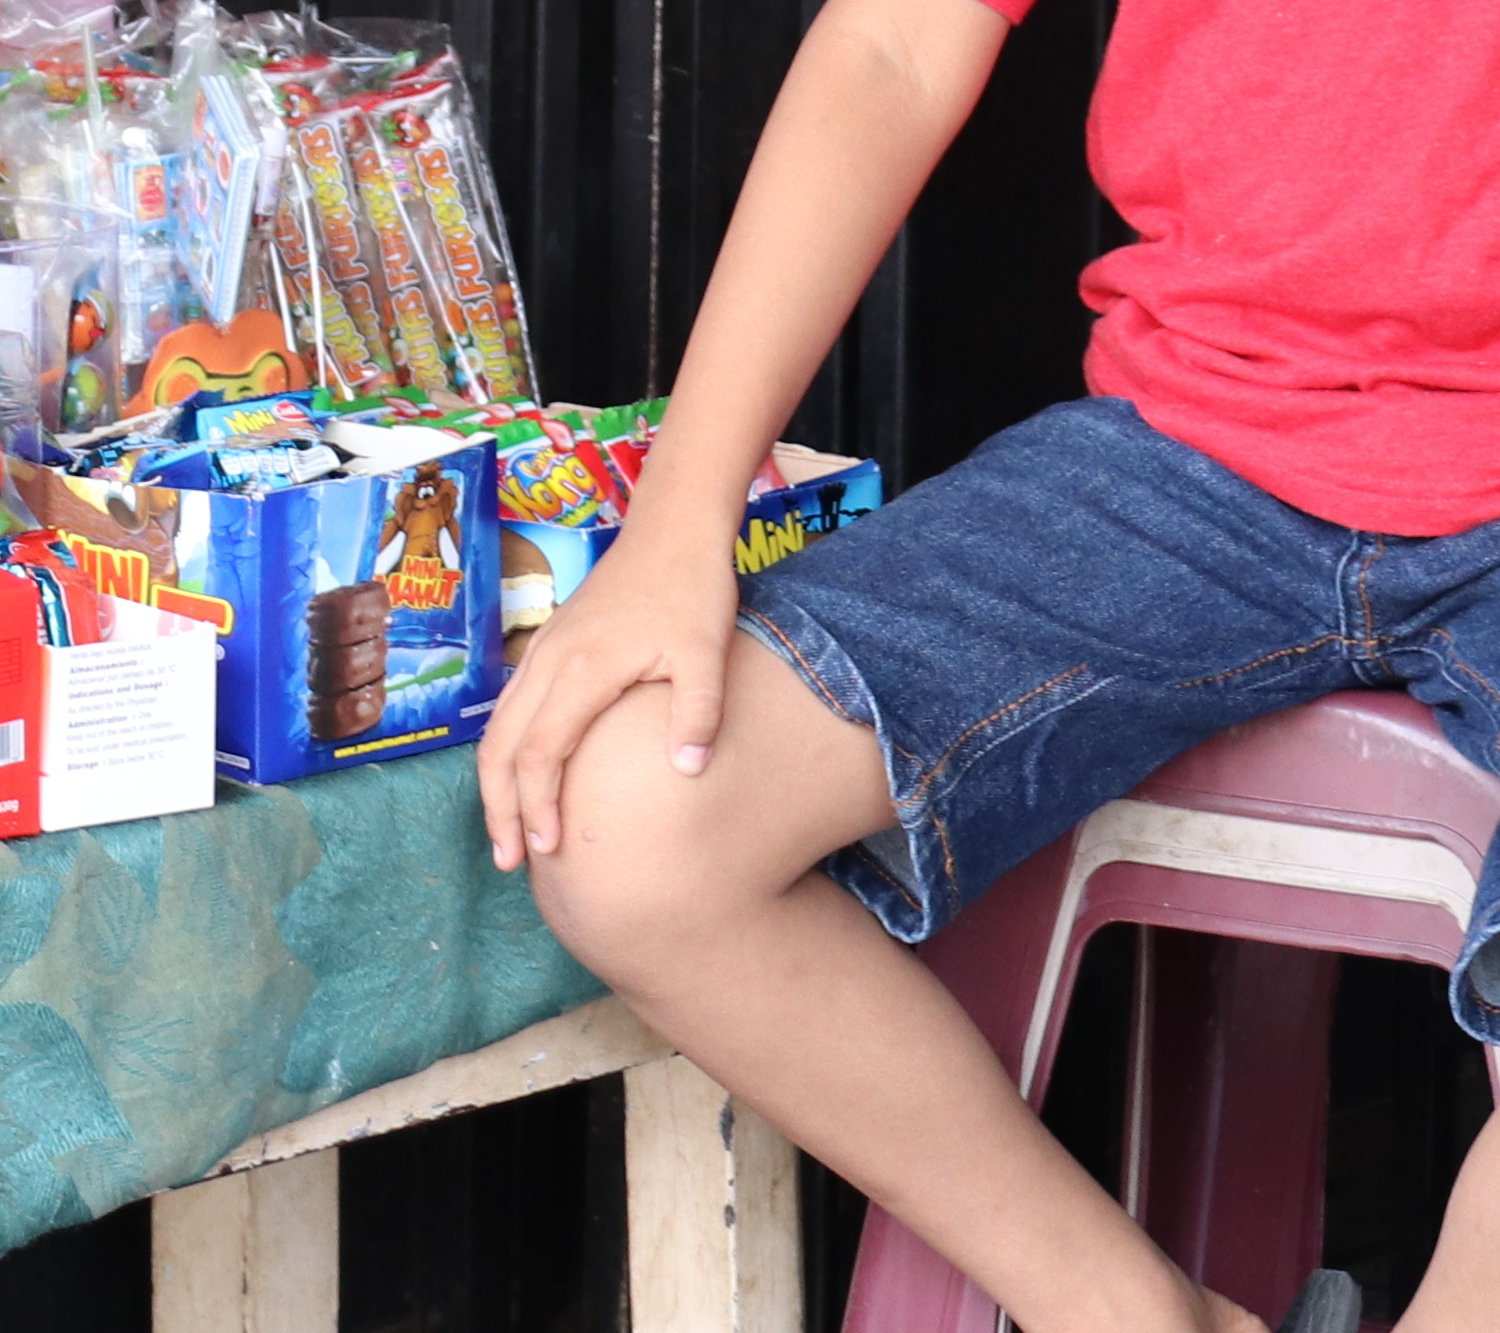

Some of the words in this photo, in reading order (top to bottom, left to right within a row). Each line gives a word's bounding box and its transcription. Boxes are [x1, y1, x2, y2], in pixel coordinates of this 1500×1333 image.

[299, 123, 370, 281] FURIOSAS
[414, 146, 493, 300] FURIOSAS
[500, 454, 595, 522] Kong
[117, 685, 131, 693] and
